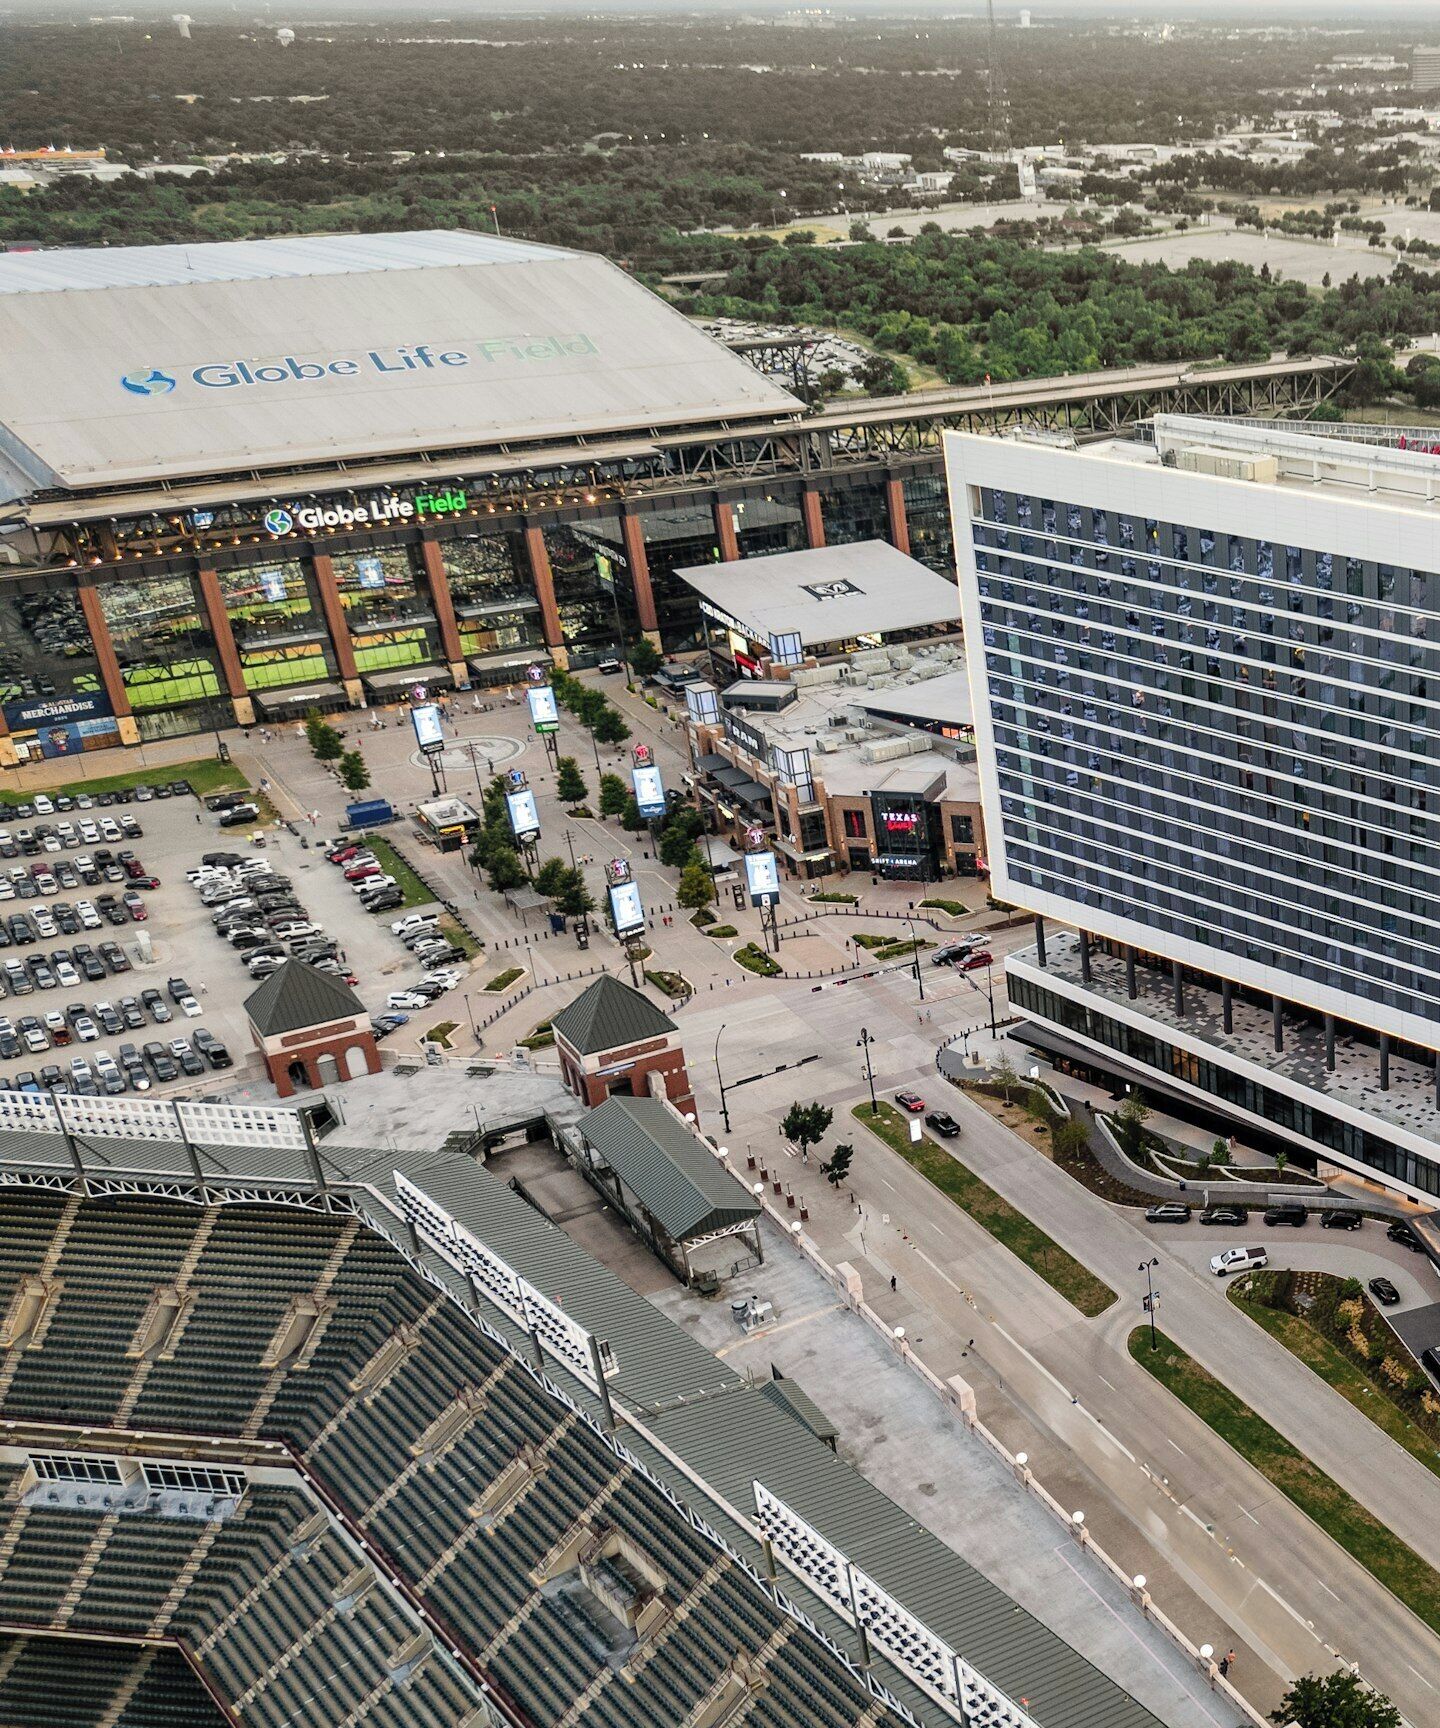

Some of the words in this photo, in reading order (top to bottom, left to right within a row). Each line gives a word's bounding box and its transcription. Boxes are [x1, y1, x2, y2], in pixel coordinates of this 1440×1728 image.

[192, 356, 360, 389] Globe
[367, 344, 471, 374] Life
[476, 333, 599, 364] Field
[298, 502, 368, 530] Globe
[369, 497, 414, 522] Life
[414, 490, 468, 516] Field
[21, 700, 95, 720] MERCHANDISE
[732, 725, 758, 750] RAM
[881, 812, 918, 822] TEXAS
[895, 858, 918, 866] ARENA
